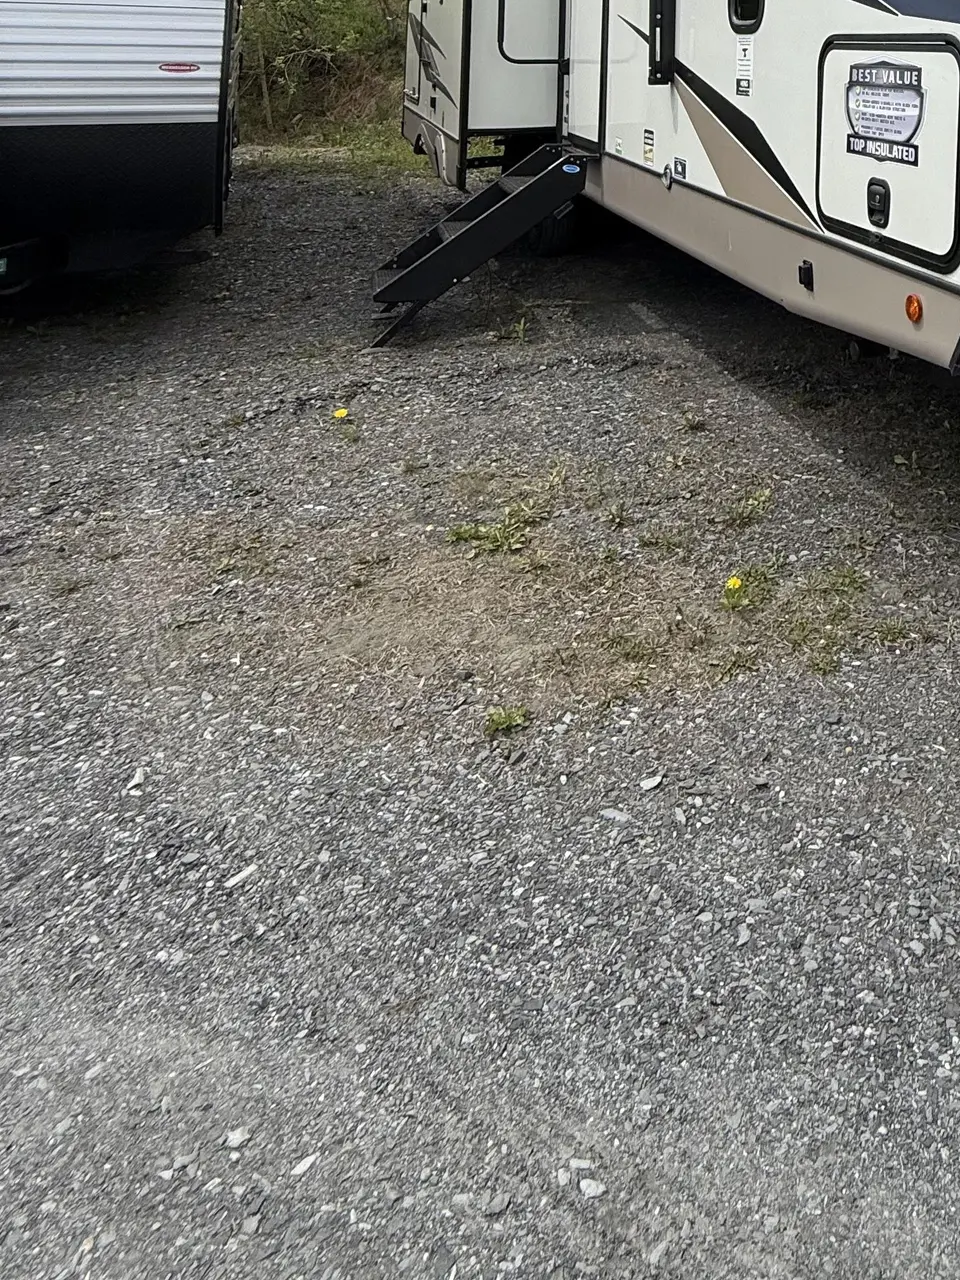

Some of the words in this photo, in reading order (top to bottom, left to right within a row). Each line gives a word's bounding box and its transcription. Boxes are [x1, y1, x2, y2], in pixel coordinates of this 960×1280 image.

[851, 68, 877, 82] BEST
[882, 70, 919, 85] VALUE
[849, 137, 865, 152] TOP
[866, 140, 916, 162] INSULATED
